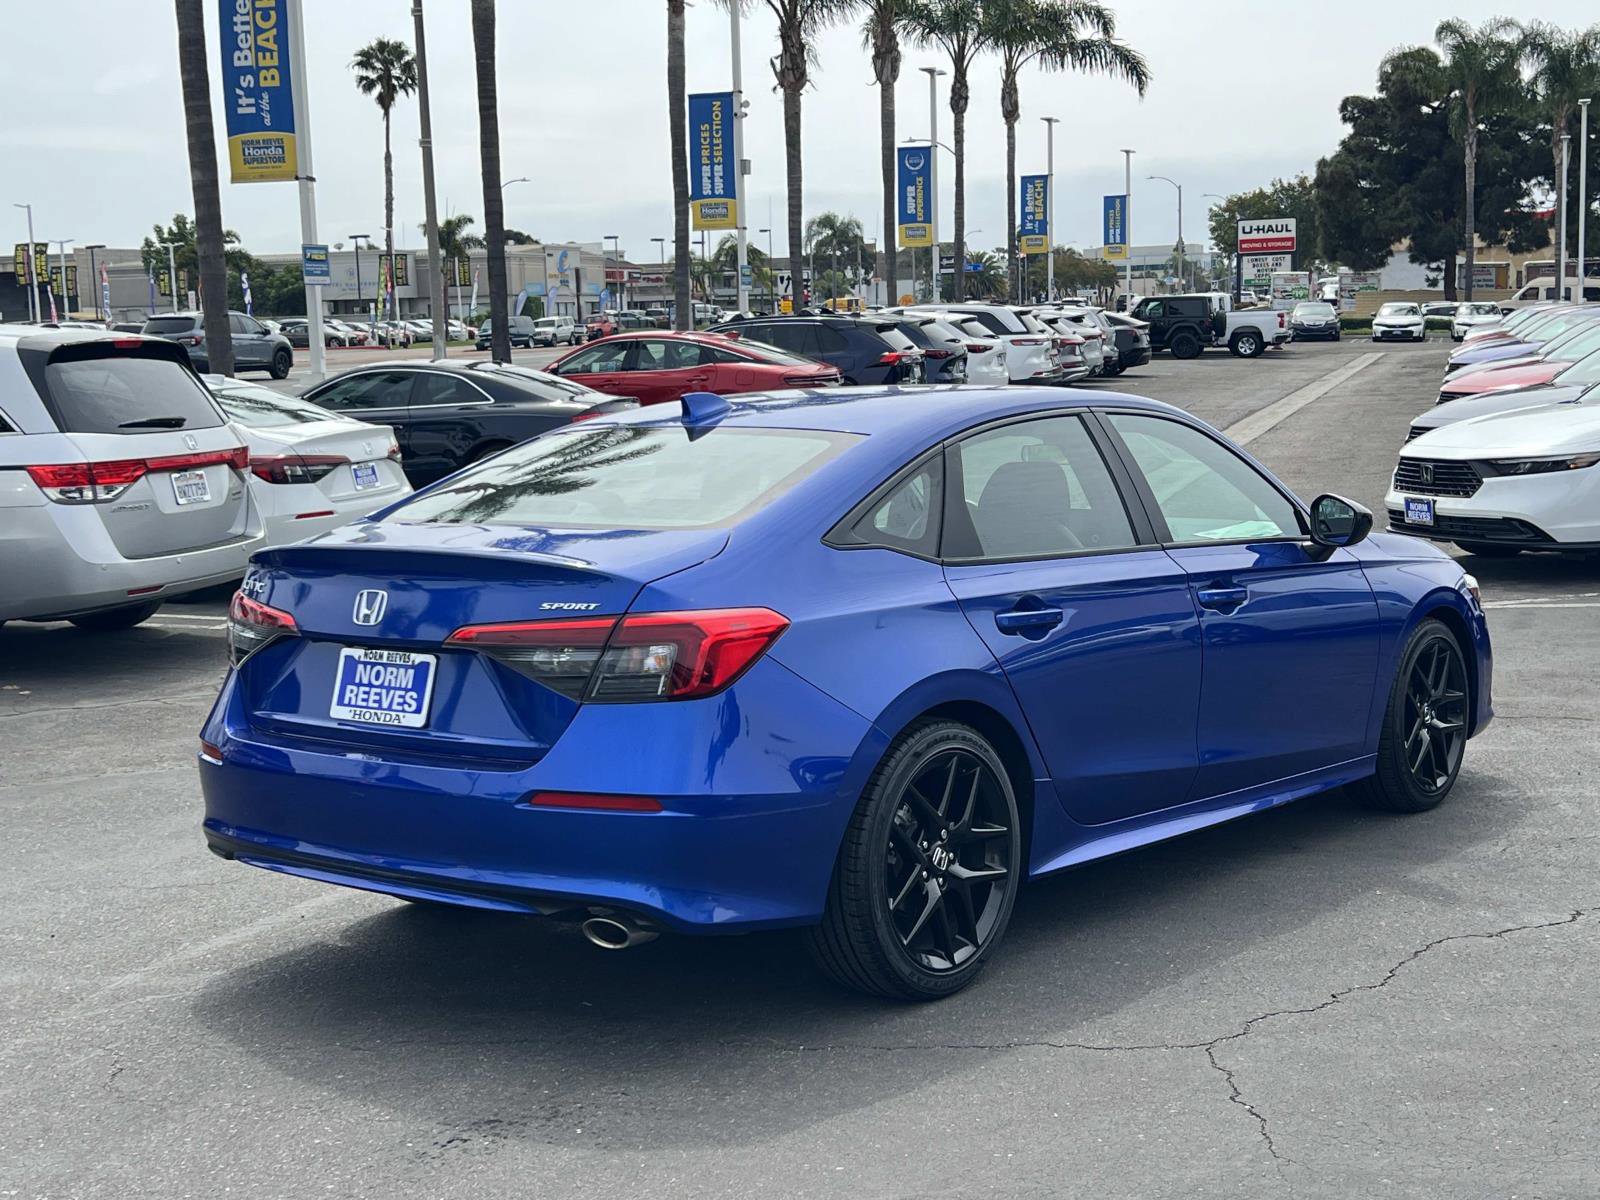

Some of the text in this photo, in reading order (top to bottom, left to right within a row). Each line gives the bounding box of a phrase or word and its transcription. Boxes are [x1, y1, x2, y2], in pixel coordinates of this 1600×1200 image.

[232, 0, 256, 114] It's Bette
[241, 138, 284, 147] NORM REEVES
[244, 146, 283, 156] Honda
[712, 101, 724, 195] SUPER SELECTION
[243, 156, 286, 165] SUPERSTORE
[701, 123, 712, 195] SUPER PRICES
[907, 185, 916, 215] SUPER
[916, 176, 924, 221] EXPERIENCE
[1025, 183, 1034, 213] Better
[1242, 223, 1292, 234] U-HAUL
[1407, 510, 1431, 521] REEVES
[1409, 502, 1428, 512] NORM
[538, 602, 601, 610] SPORT
[364, 650, 412, 664] NORM REEVES
[354, 663, 416, 689] NORM
[343, 684, 418, 713] REEVES
